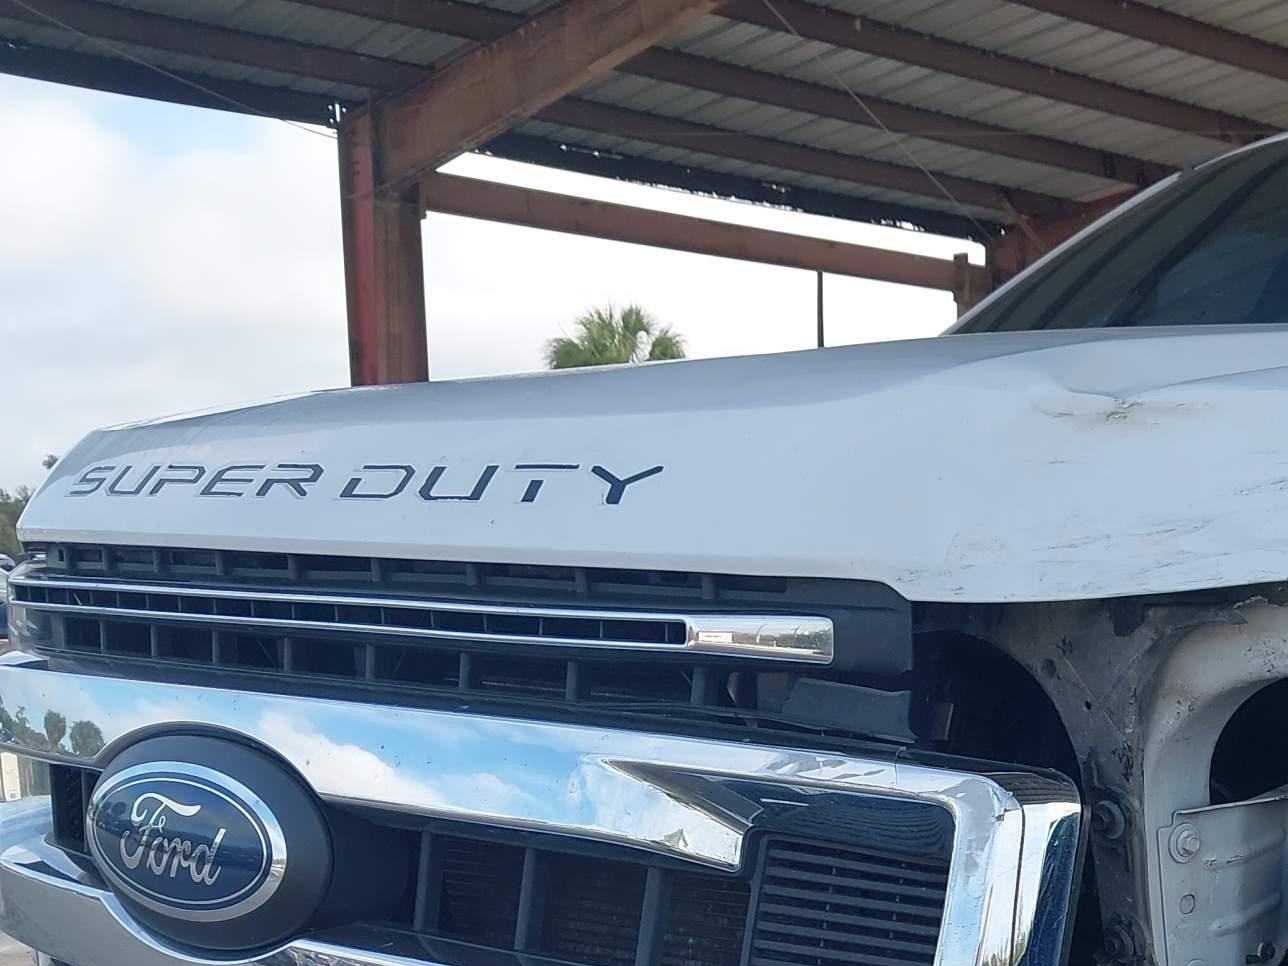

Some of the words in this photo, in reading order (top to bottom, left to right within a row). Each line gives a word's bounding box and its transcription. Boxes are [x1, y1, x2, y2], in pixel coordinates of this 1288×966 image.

[66, 463, 325, 498] SUPER
[338, 464, 664, 505] DUTY
[120, 792, 227, 886] Ford
